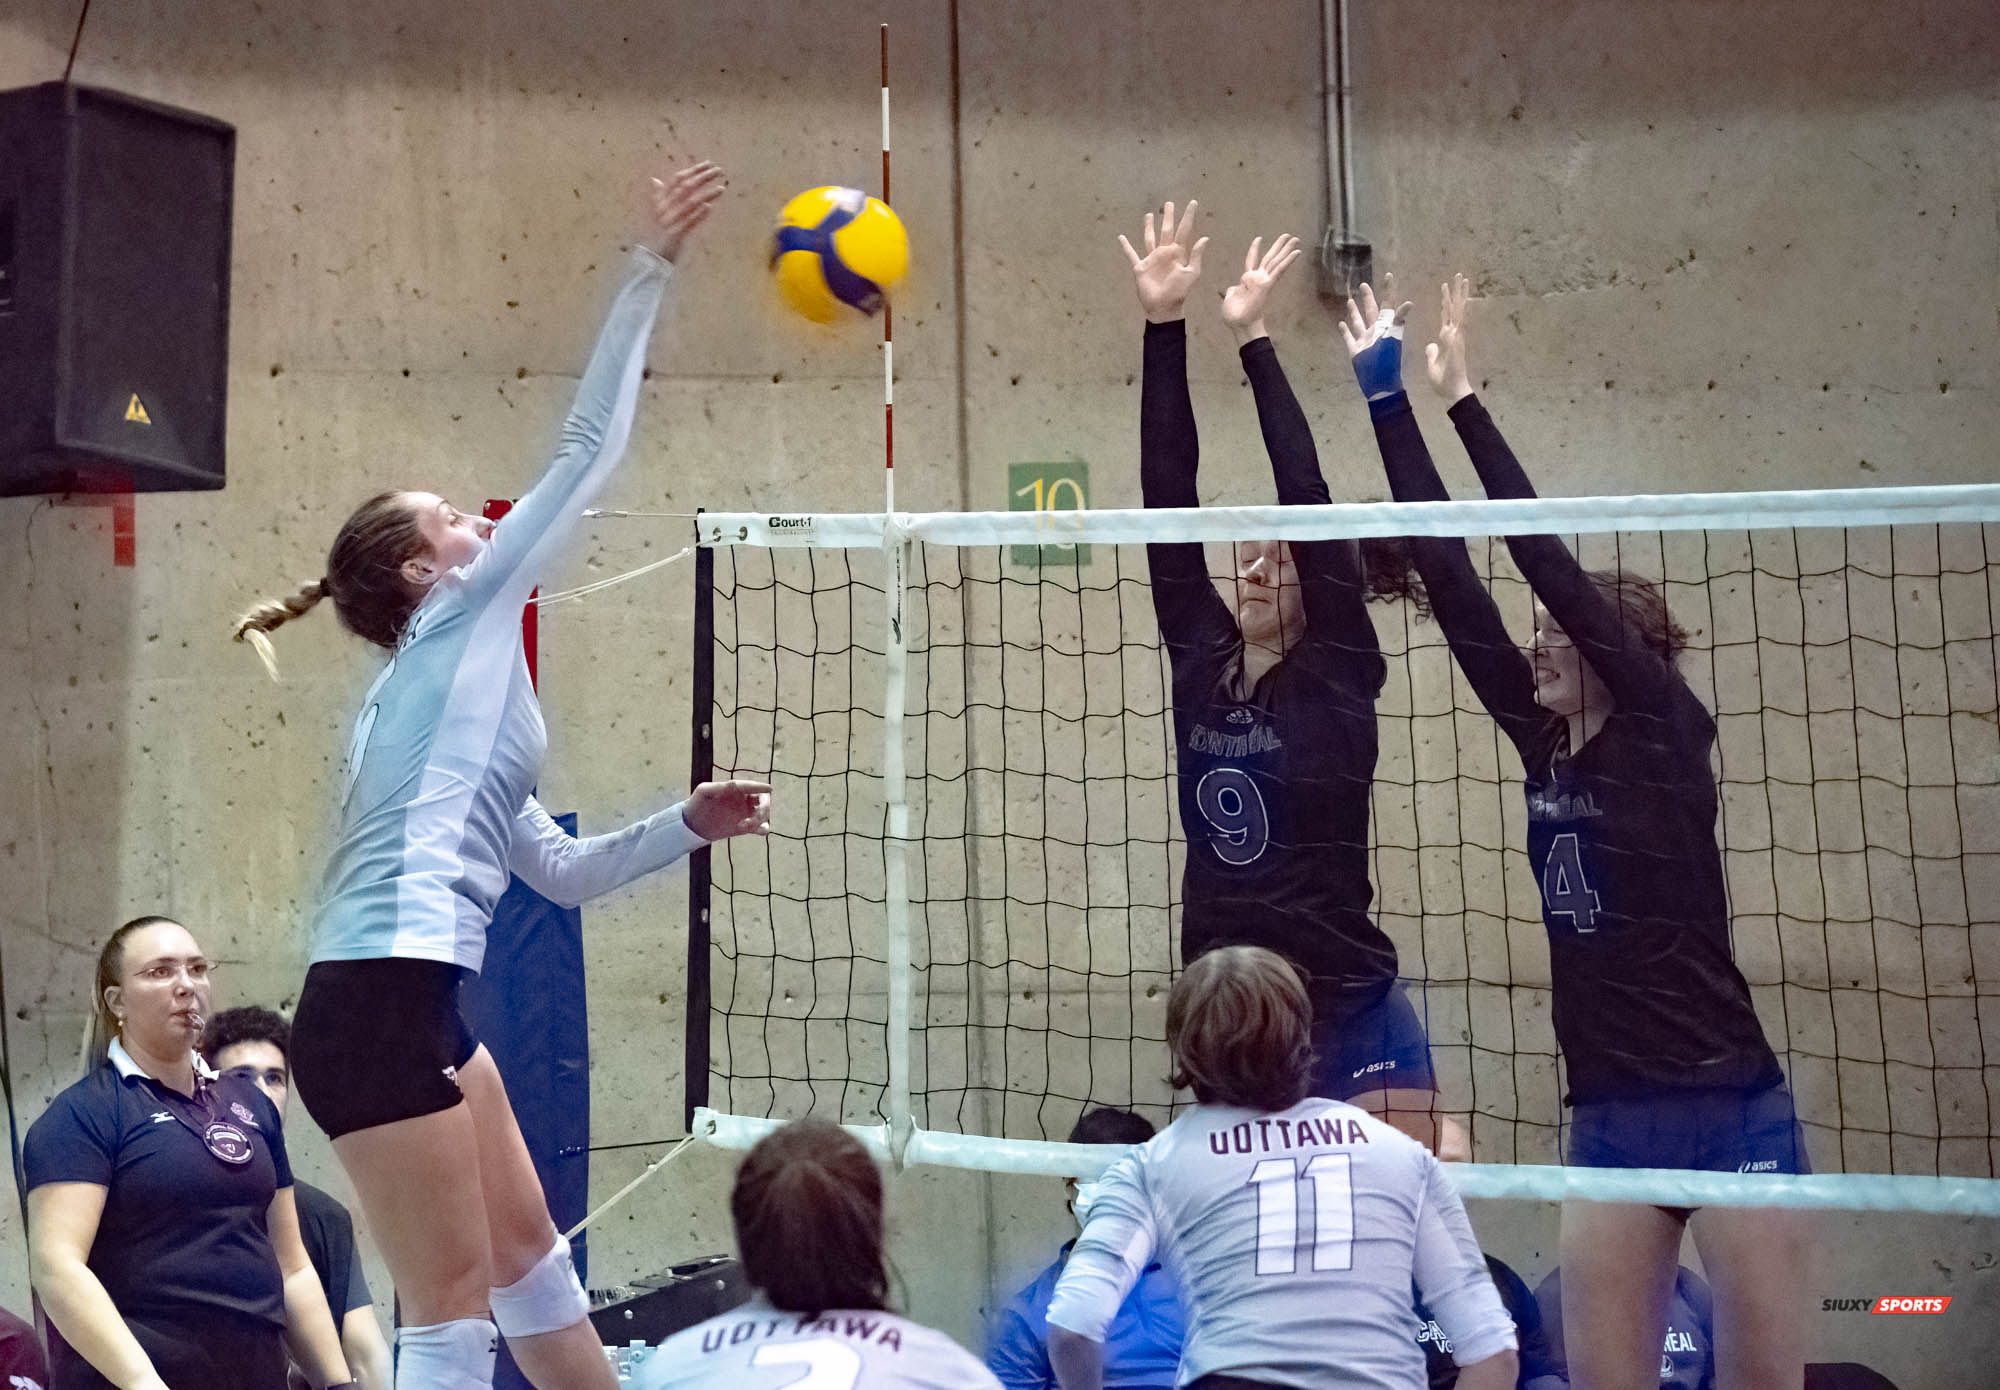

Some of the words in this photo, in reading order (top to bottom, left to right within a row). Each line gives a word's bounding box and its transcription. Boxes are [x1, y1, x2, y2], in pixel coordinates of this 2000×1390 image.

[1016, 478, 1086, 550] 10
[1196, 767, 1269, 866] 9
[1543, 832, 1602, 933] 4
[1247, 1152, 1355, 1276] 11
